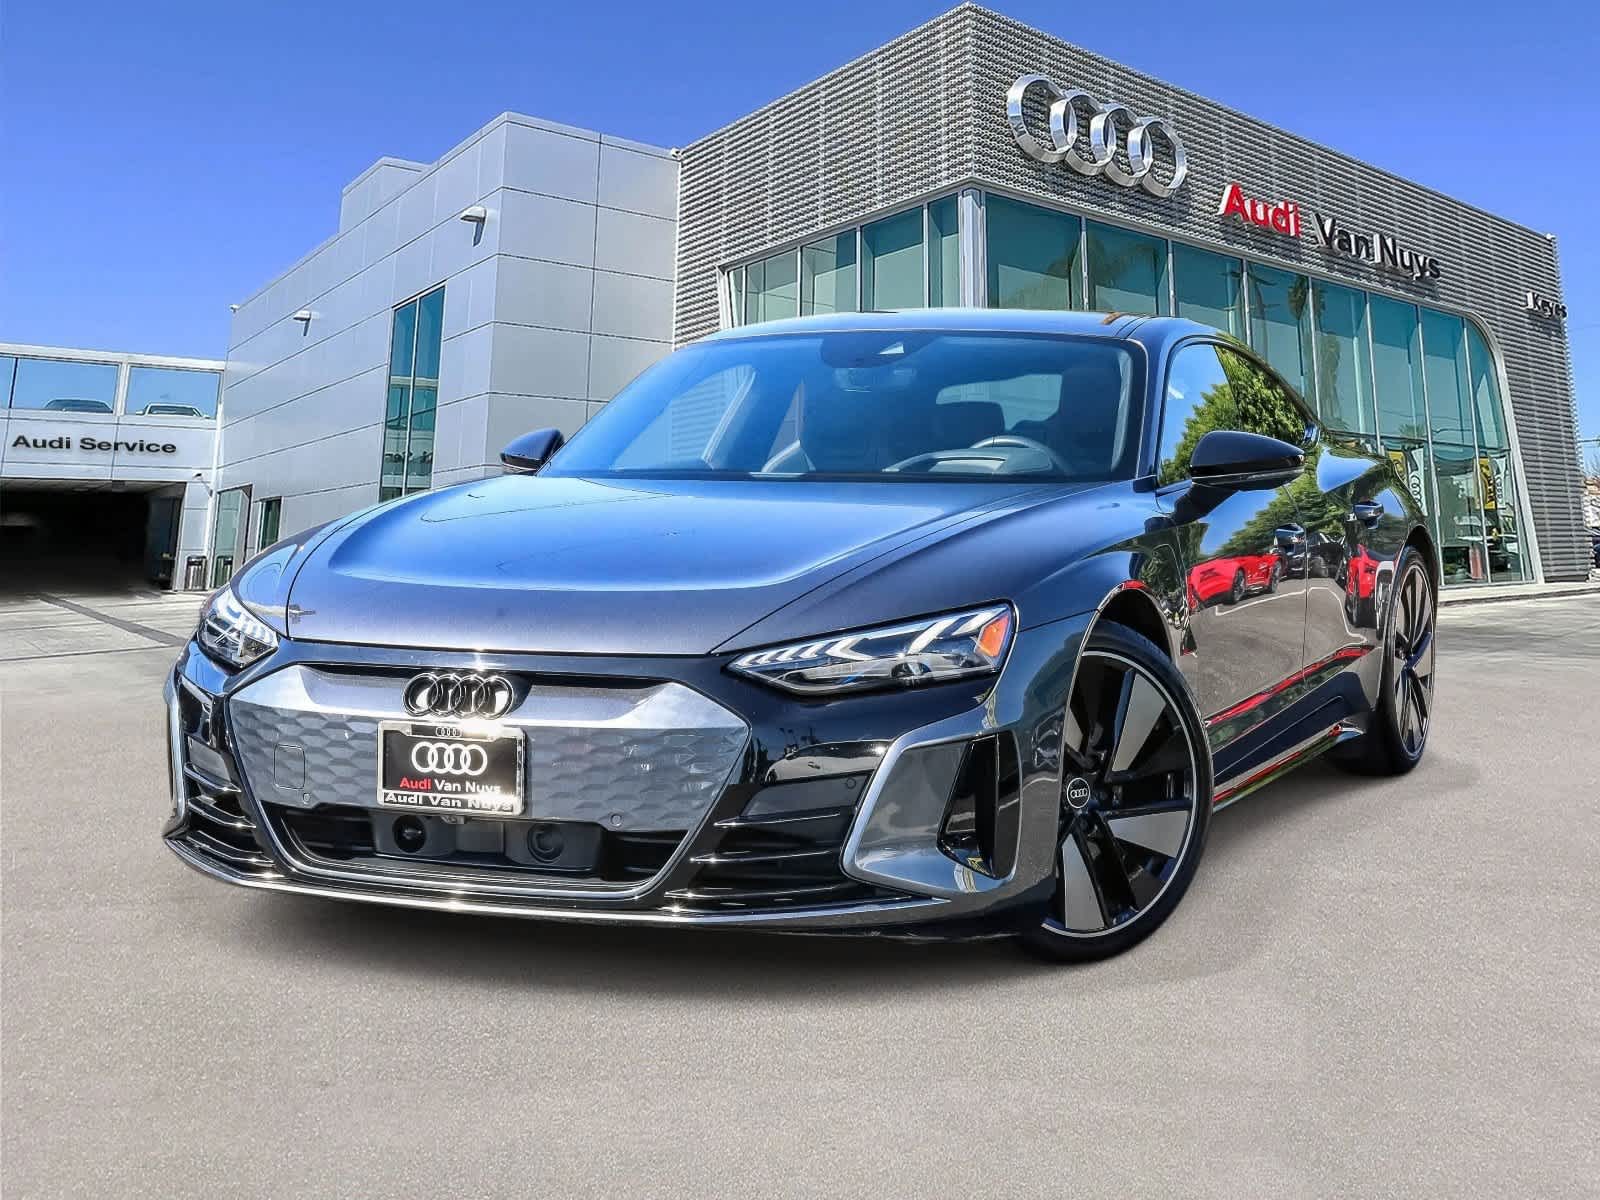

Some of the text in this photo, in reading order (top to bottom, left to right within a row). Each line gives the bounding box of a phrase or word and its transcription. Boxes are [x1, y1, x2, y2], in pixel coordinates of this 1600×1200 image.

[1218, 181, 1441, 280] Audi Van Nuys
[12, 435, 177, 453] Audi Service
[400, 777, 431, 790] Audi
[434, 779, 462, 793] Van
[384, 792, 422, 804] Audi
[429, 796, 462, 808] Van
